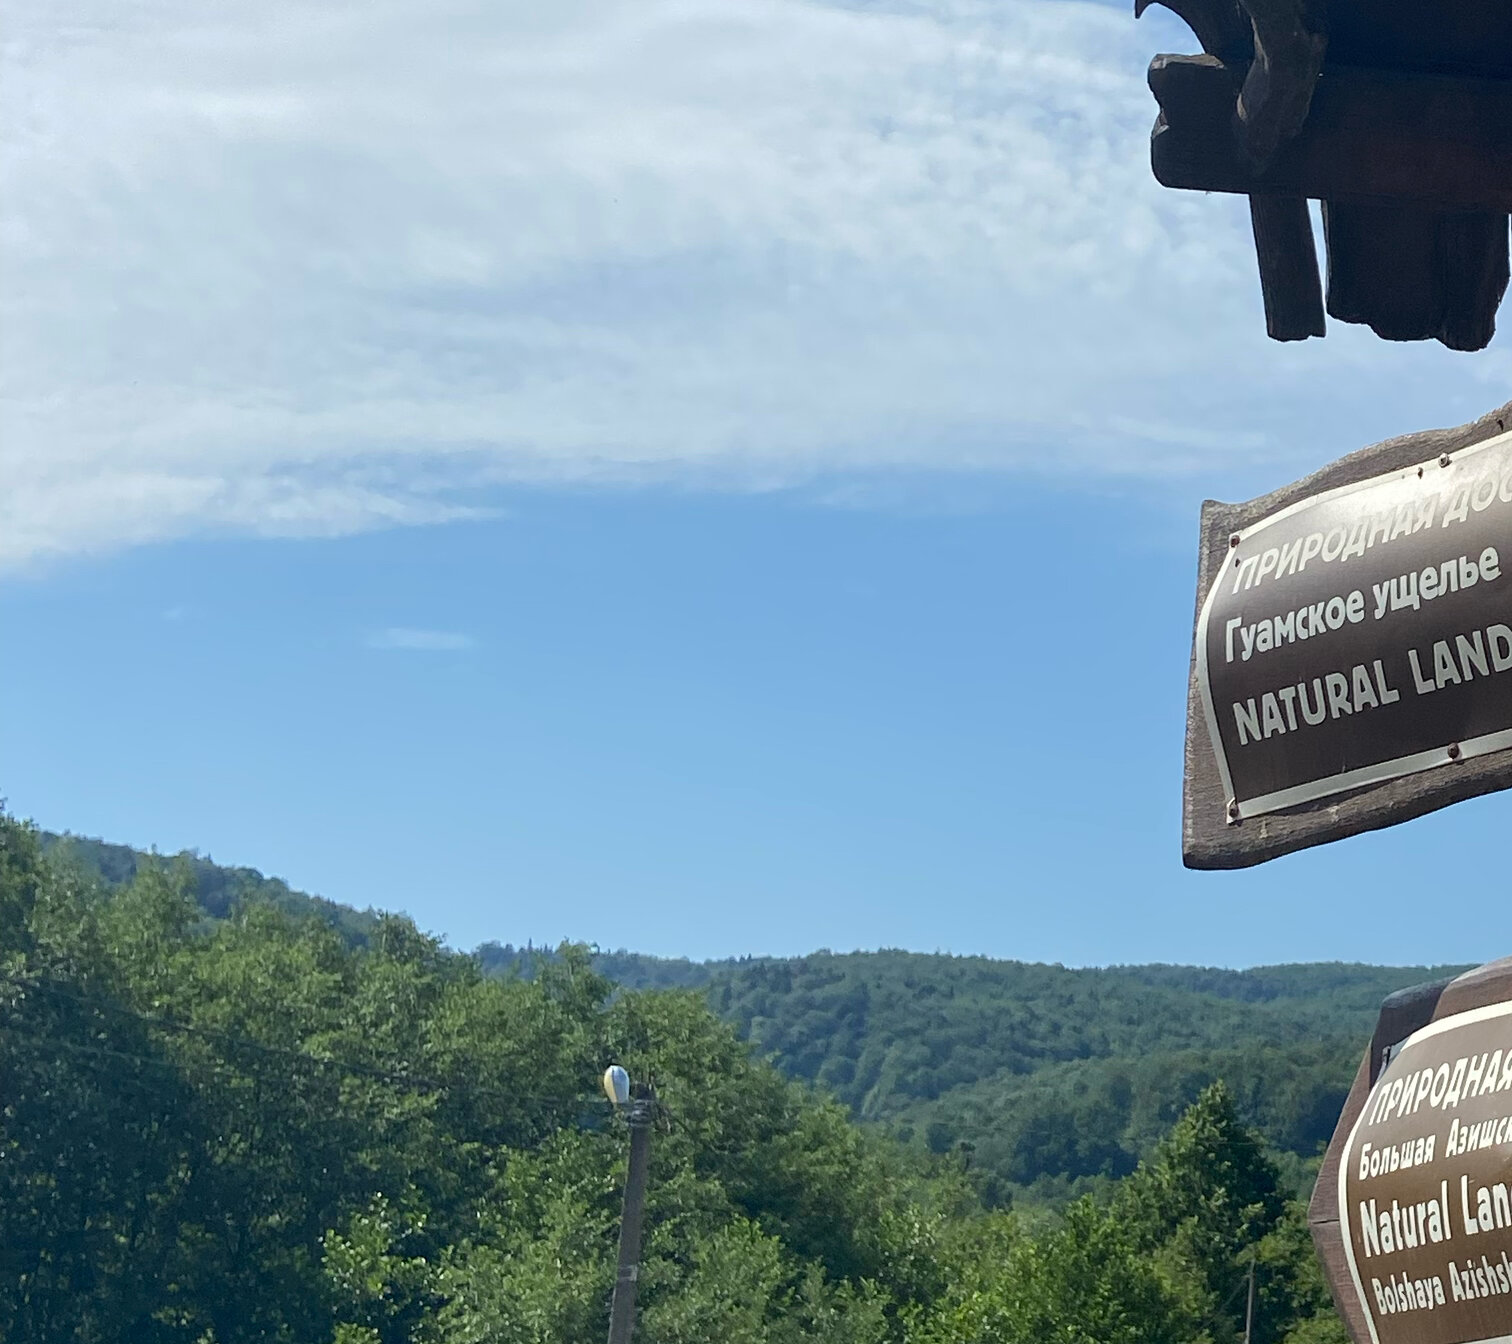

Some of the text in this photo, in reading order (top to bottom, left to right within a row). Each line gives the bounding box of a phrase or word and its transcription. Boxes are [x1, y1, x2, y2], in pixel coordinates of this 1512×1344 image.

[1232, 487, 1440, 594] ПРИРОДНАЯ
[1225, 546, 1501, 663] Гуамское ущелье
[1232, 658, 1400, 746] NATURAL
[1359, 1133, 1435, 1180] Большая
[1359, 1180, 1450, 1257] Natural
[1371, 1266, 1444, 1315] Bolshaya
